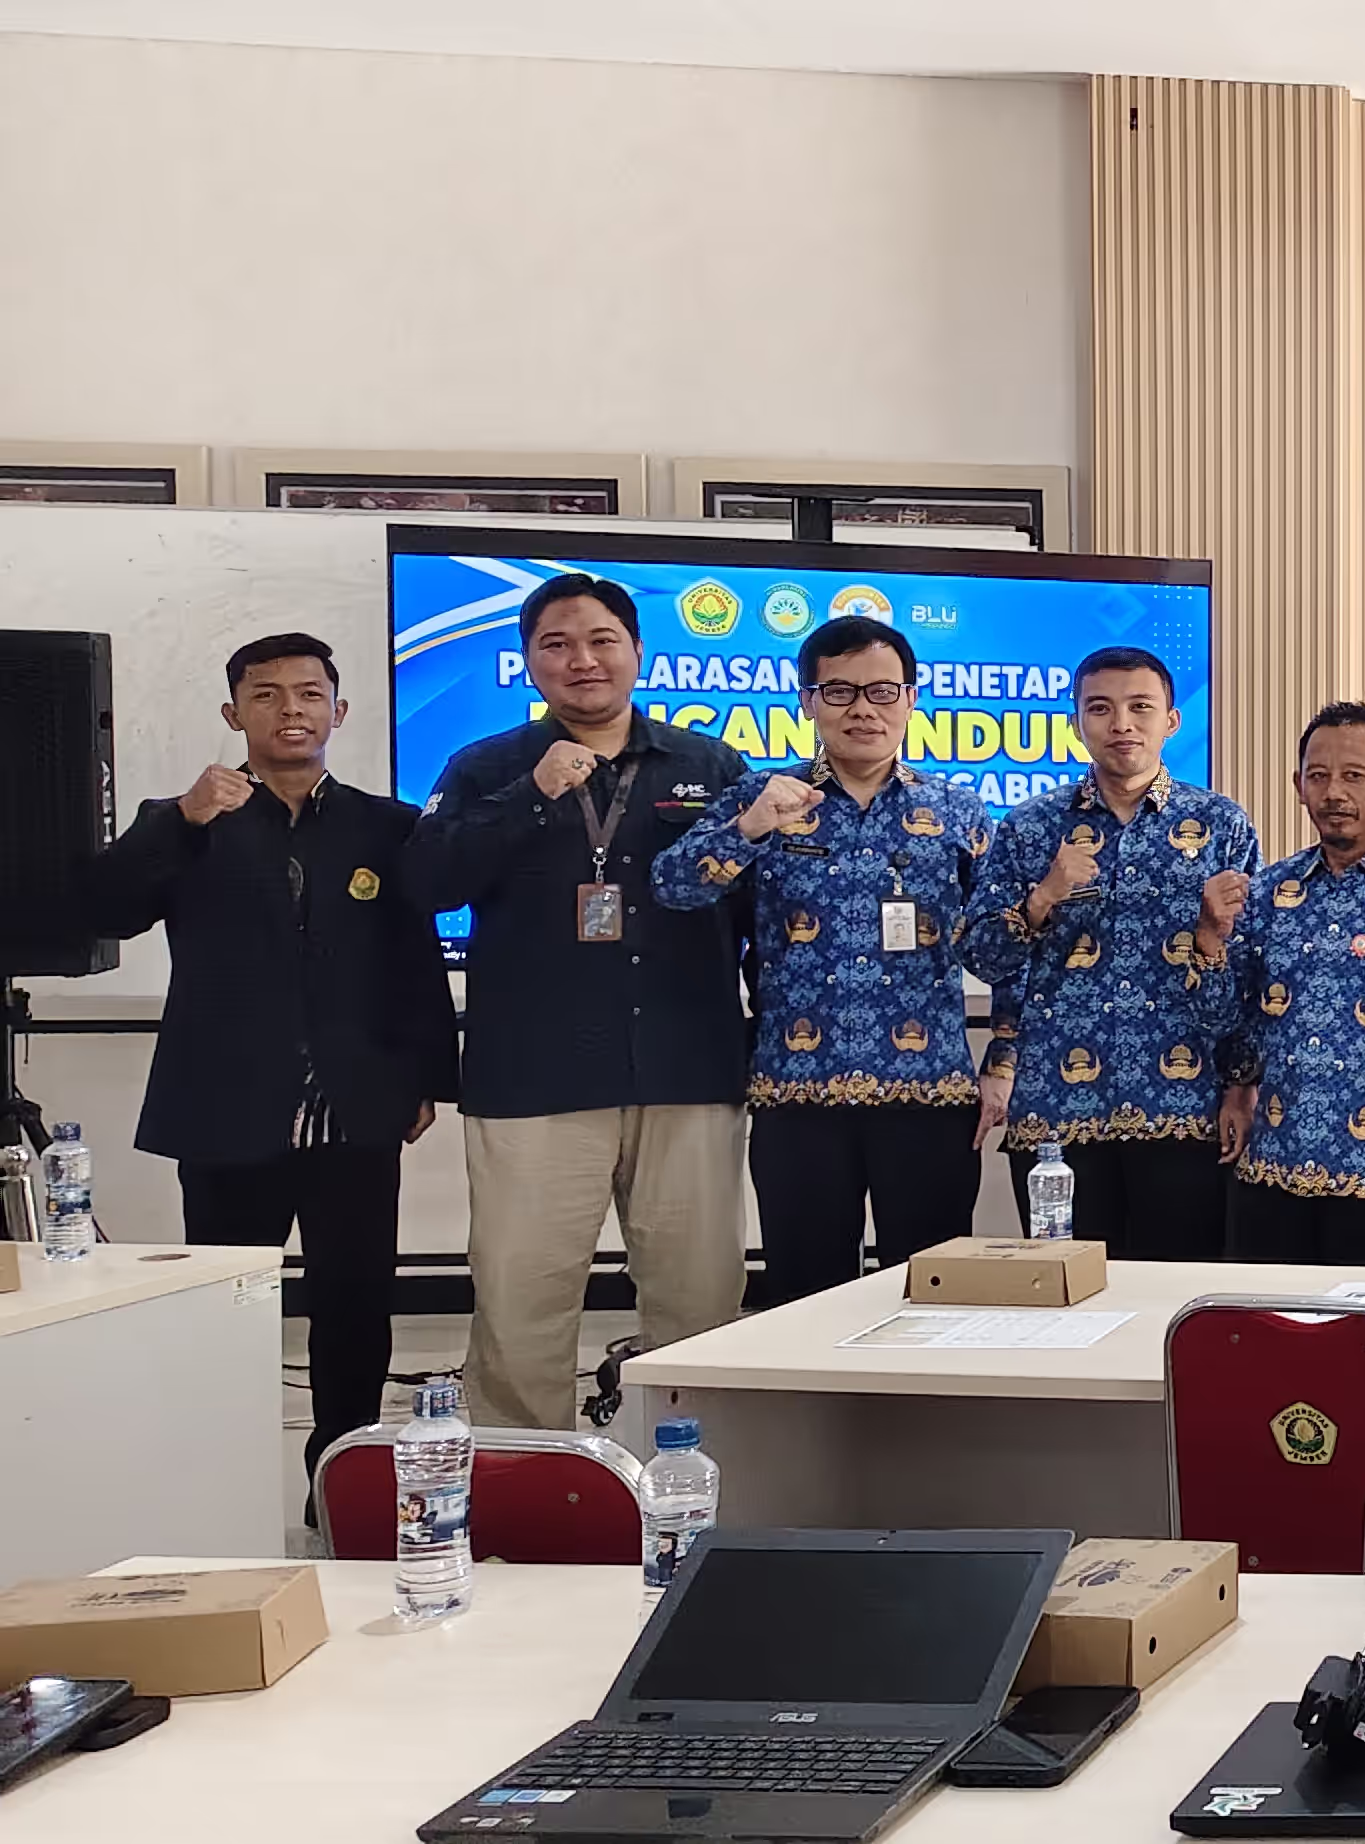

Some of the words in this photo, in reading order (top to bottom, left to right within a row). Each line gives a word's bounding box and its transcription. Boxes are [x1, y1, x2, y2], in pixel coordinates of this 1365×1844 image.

[911, 605, 957, 622] BLU
[914, 664, 1074, 699] PENETAP
[897, 710, 1093, 763] NDUK
[770, 1712, 818, 1722] ASUS
